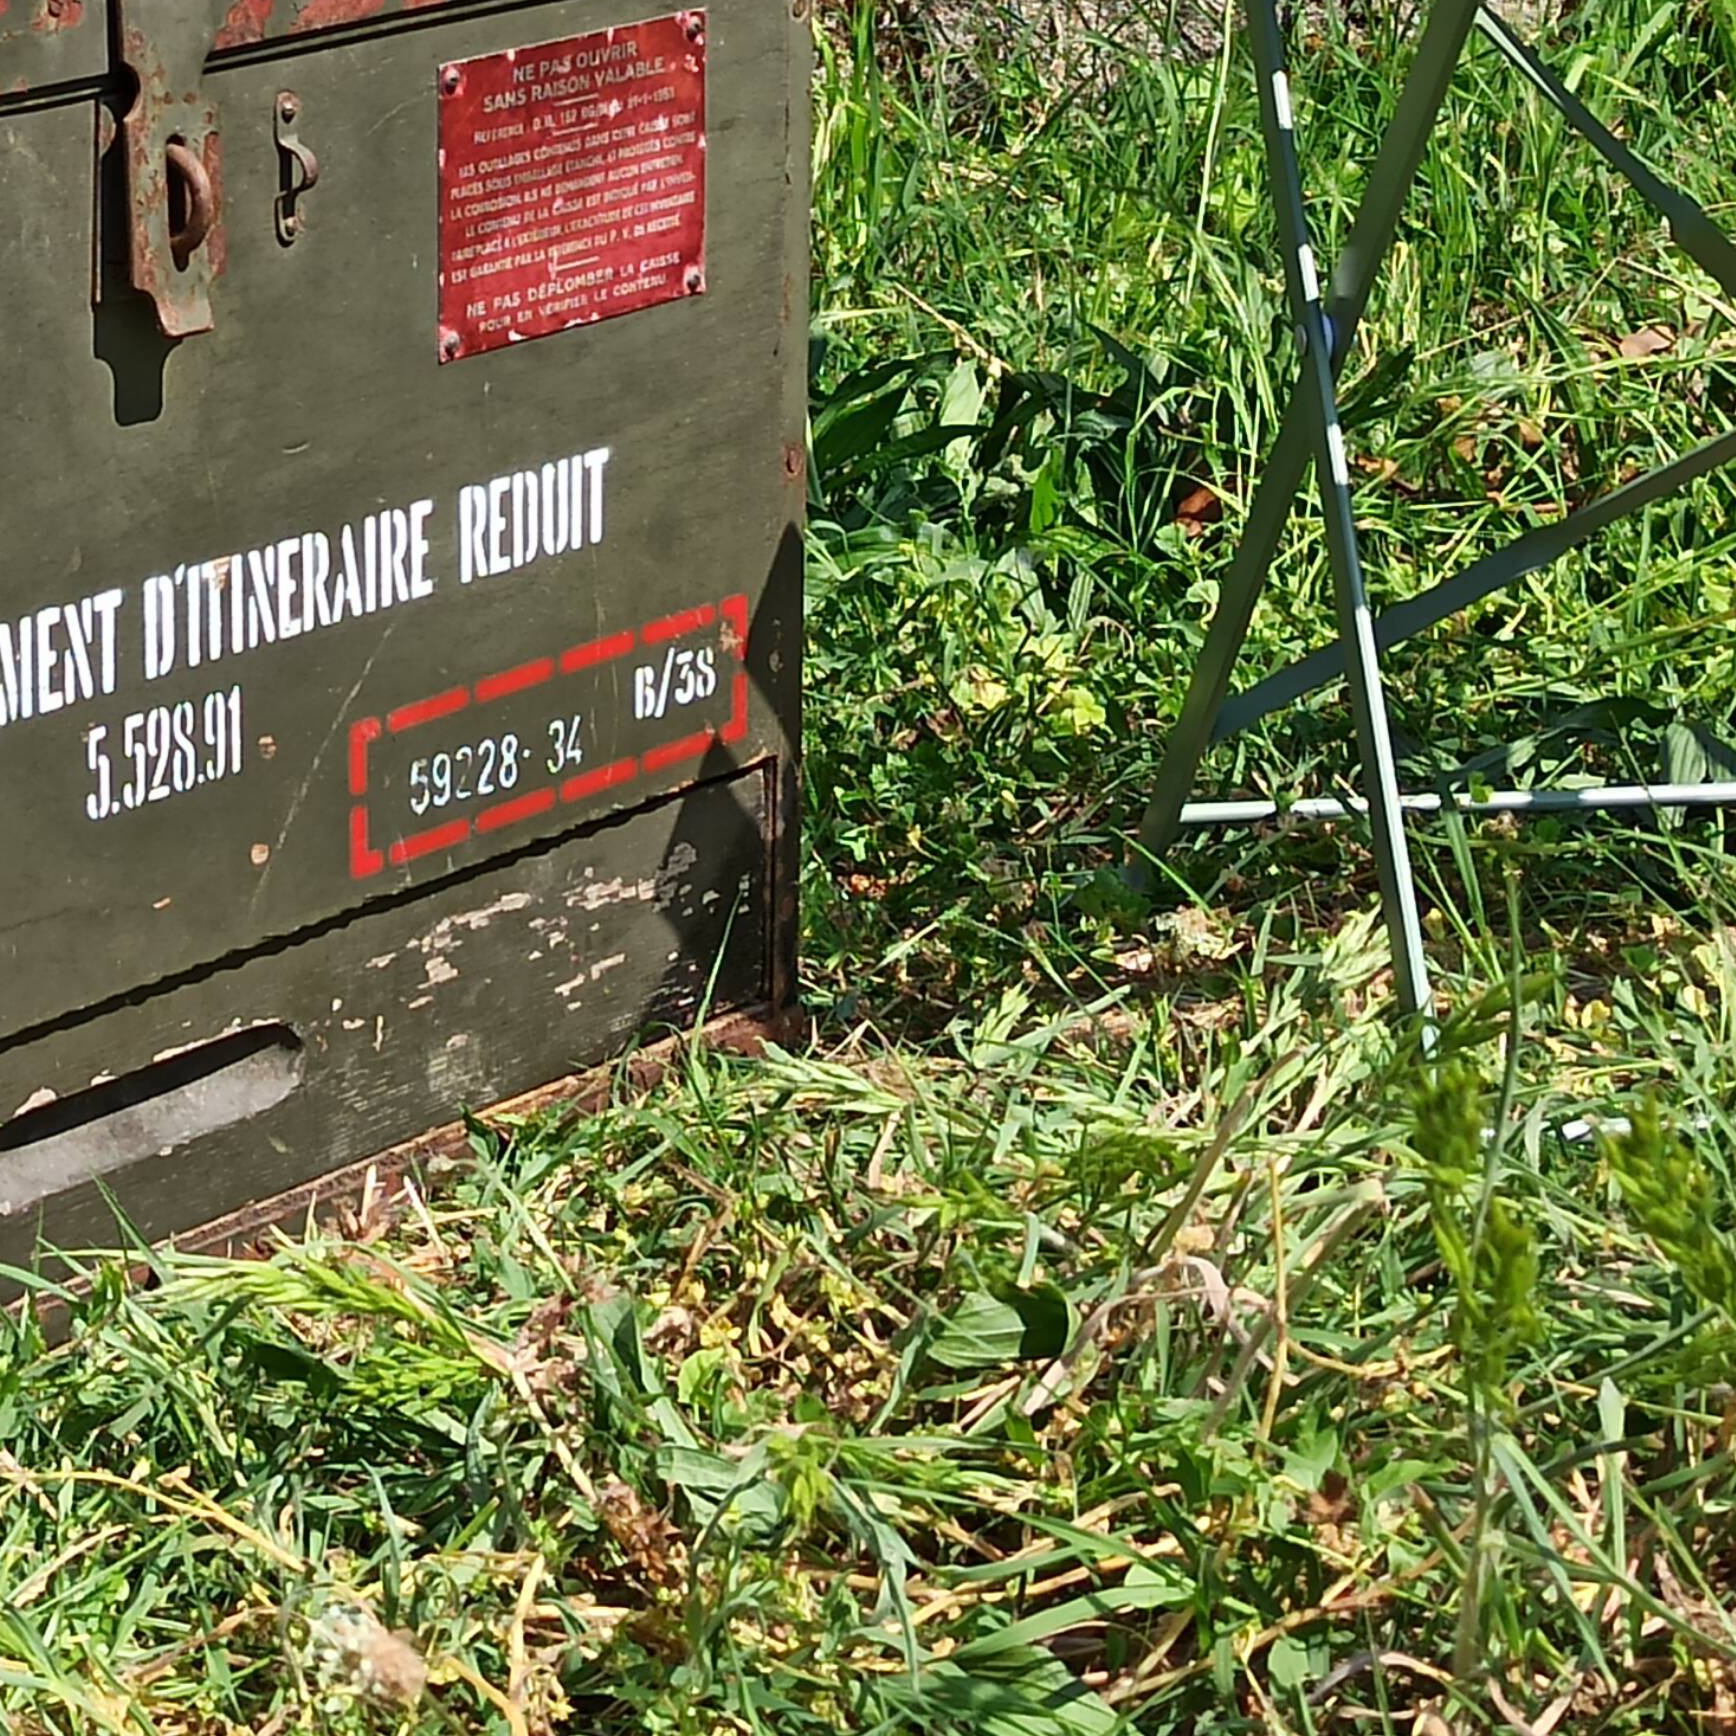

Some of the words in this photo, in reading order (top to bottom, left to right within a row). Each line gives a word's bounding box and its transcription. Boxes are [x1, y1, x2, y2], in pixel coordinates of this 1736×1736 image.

[483, 86, 526, 114] SANS
[531, 72, 590, 103] RAISON
[595, 55, 664, 88] VALABLE
[513, 62, 535, 84] NE
[539, 54, 571, 78] PAS
[576, 39, 637, 70] OUVRIR
[465, 298, 487, 320] NE
[493, 289, 521, 313] PAS
[619, 261, 634, 281] LA
[639, 249, 680, 276] CAISSE
[478, 312, 511, 334] POUR
[516, 306, 533, 324] EN
[593, 287, 607, 305] LE
[143, 498, 435, 680] D'ITINERAIRE
[458, 446, 612, 584] REDUIT
[86, 684, 242, 820] 5.528.91
[546, 714, 584, 775] 34
